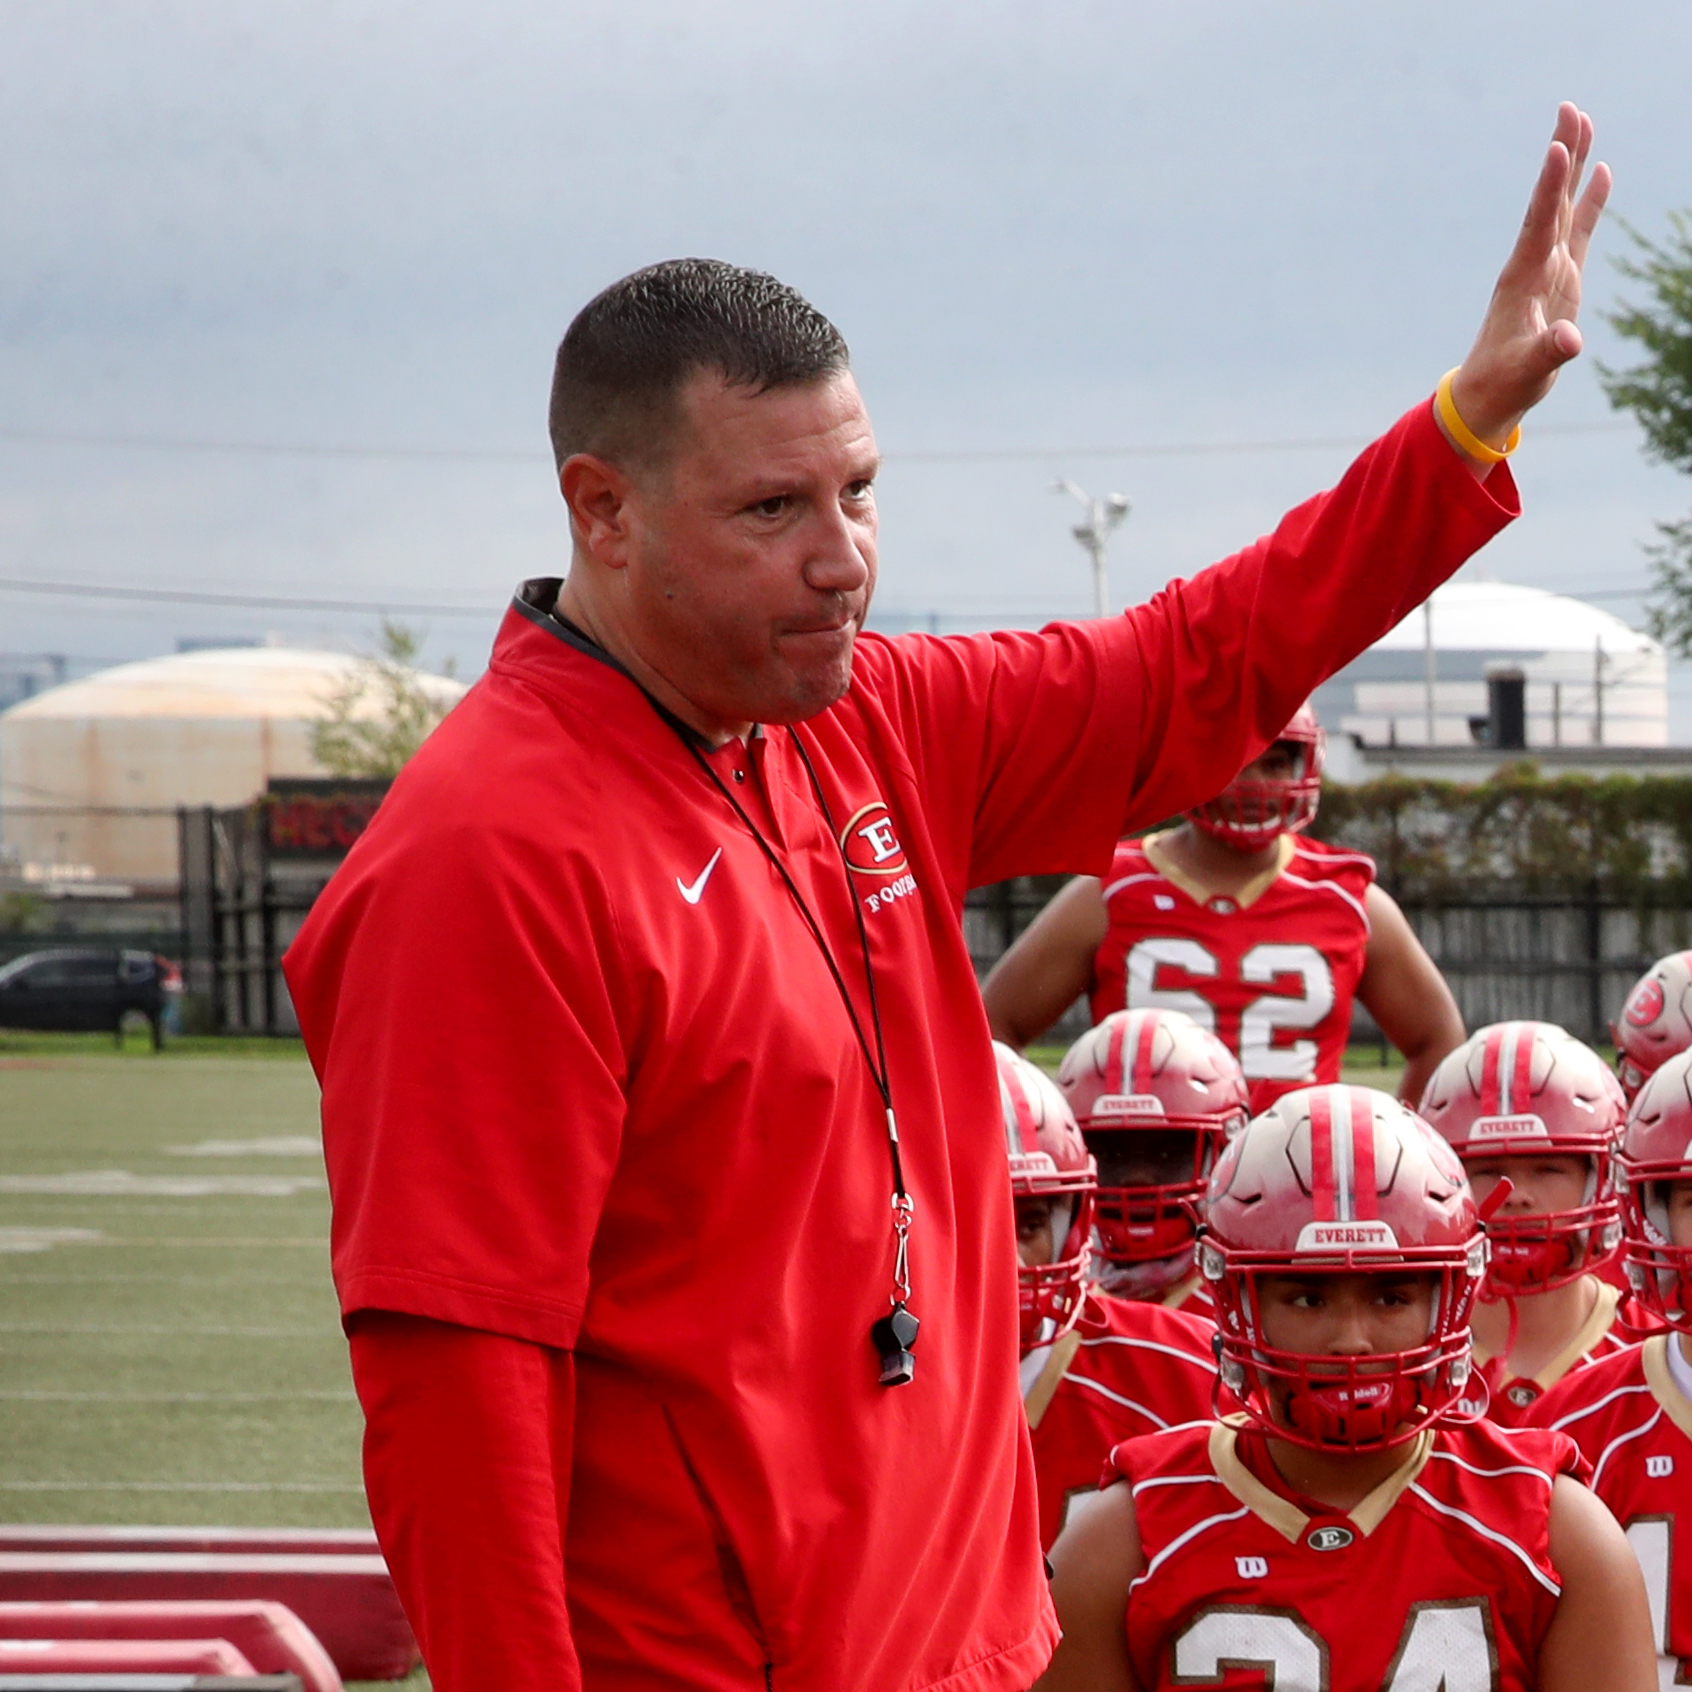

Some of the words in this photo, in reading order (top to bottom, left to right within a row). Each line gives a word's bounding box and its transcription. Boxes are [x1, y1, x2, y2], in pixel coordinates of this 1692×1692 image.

[858, 816, 902, 863] E
[1126, 937, 1336, 1081] 62
[1314, 1229, 1386, 1243] EVERETT
